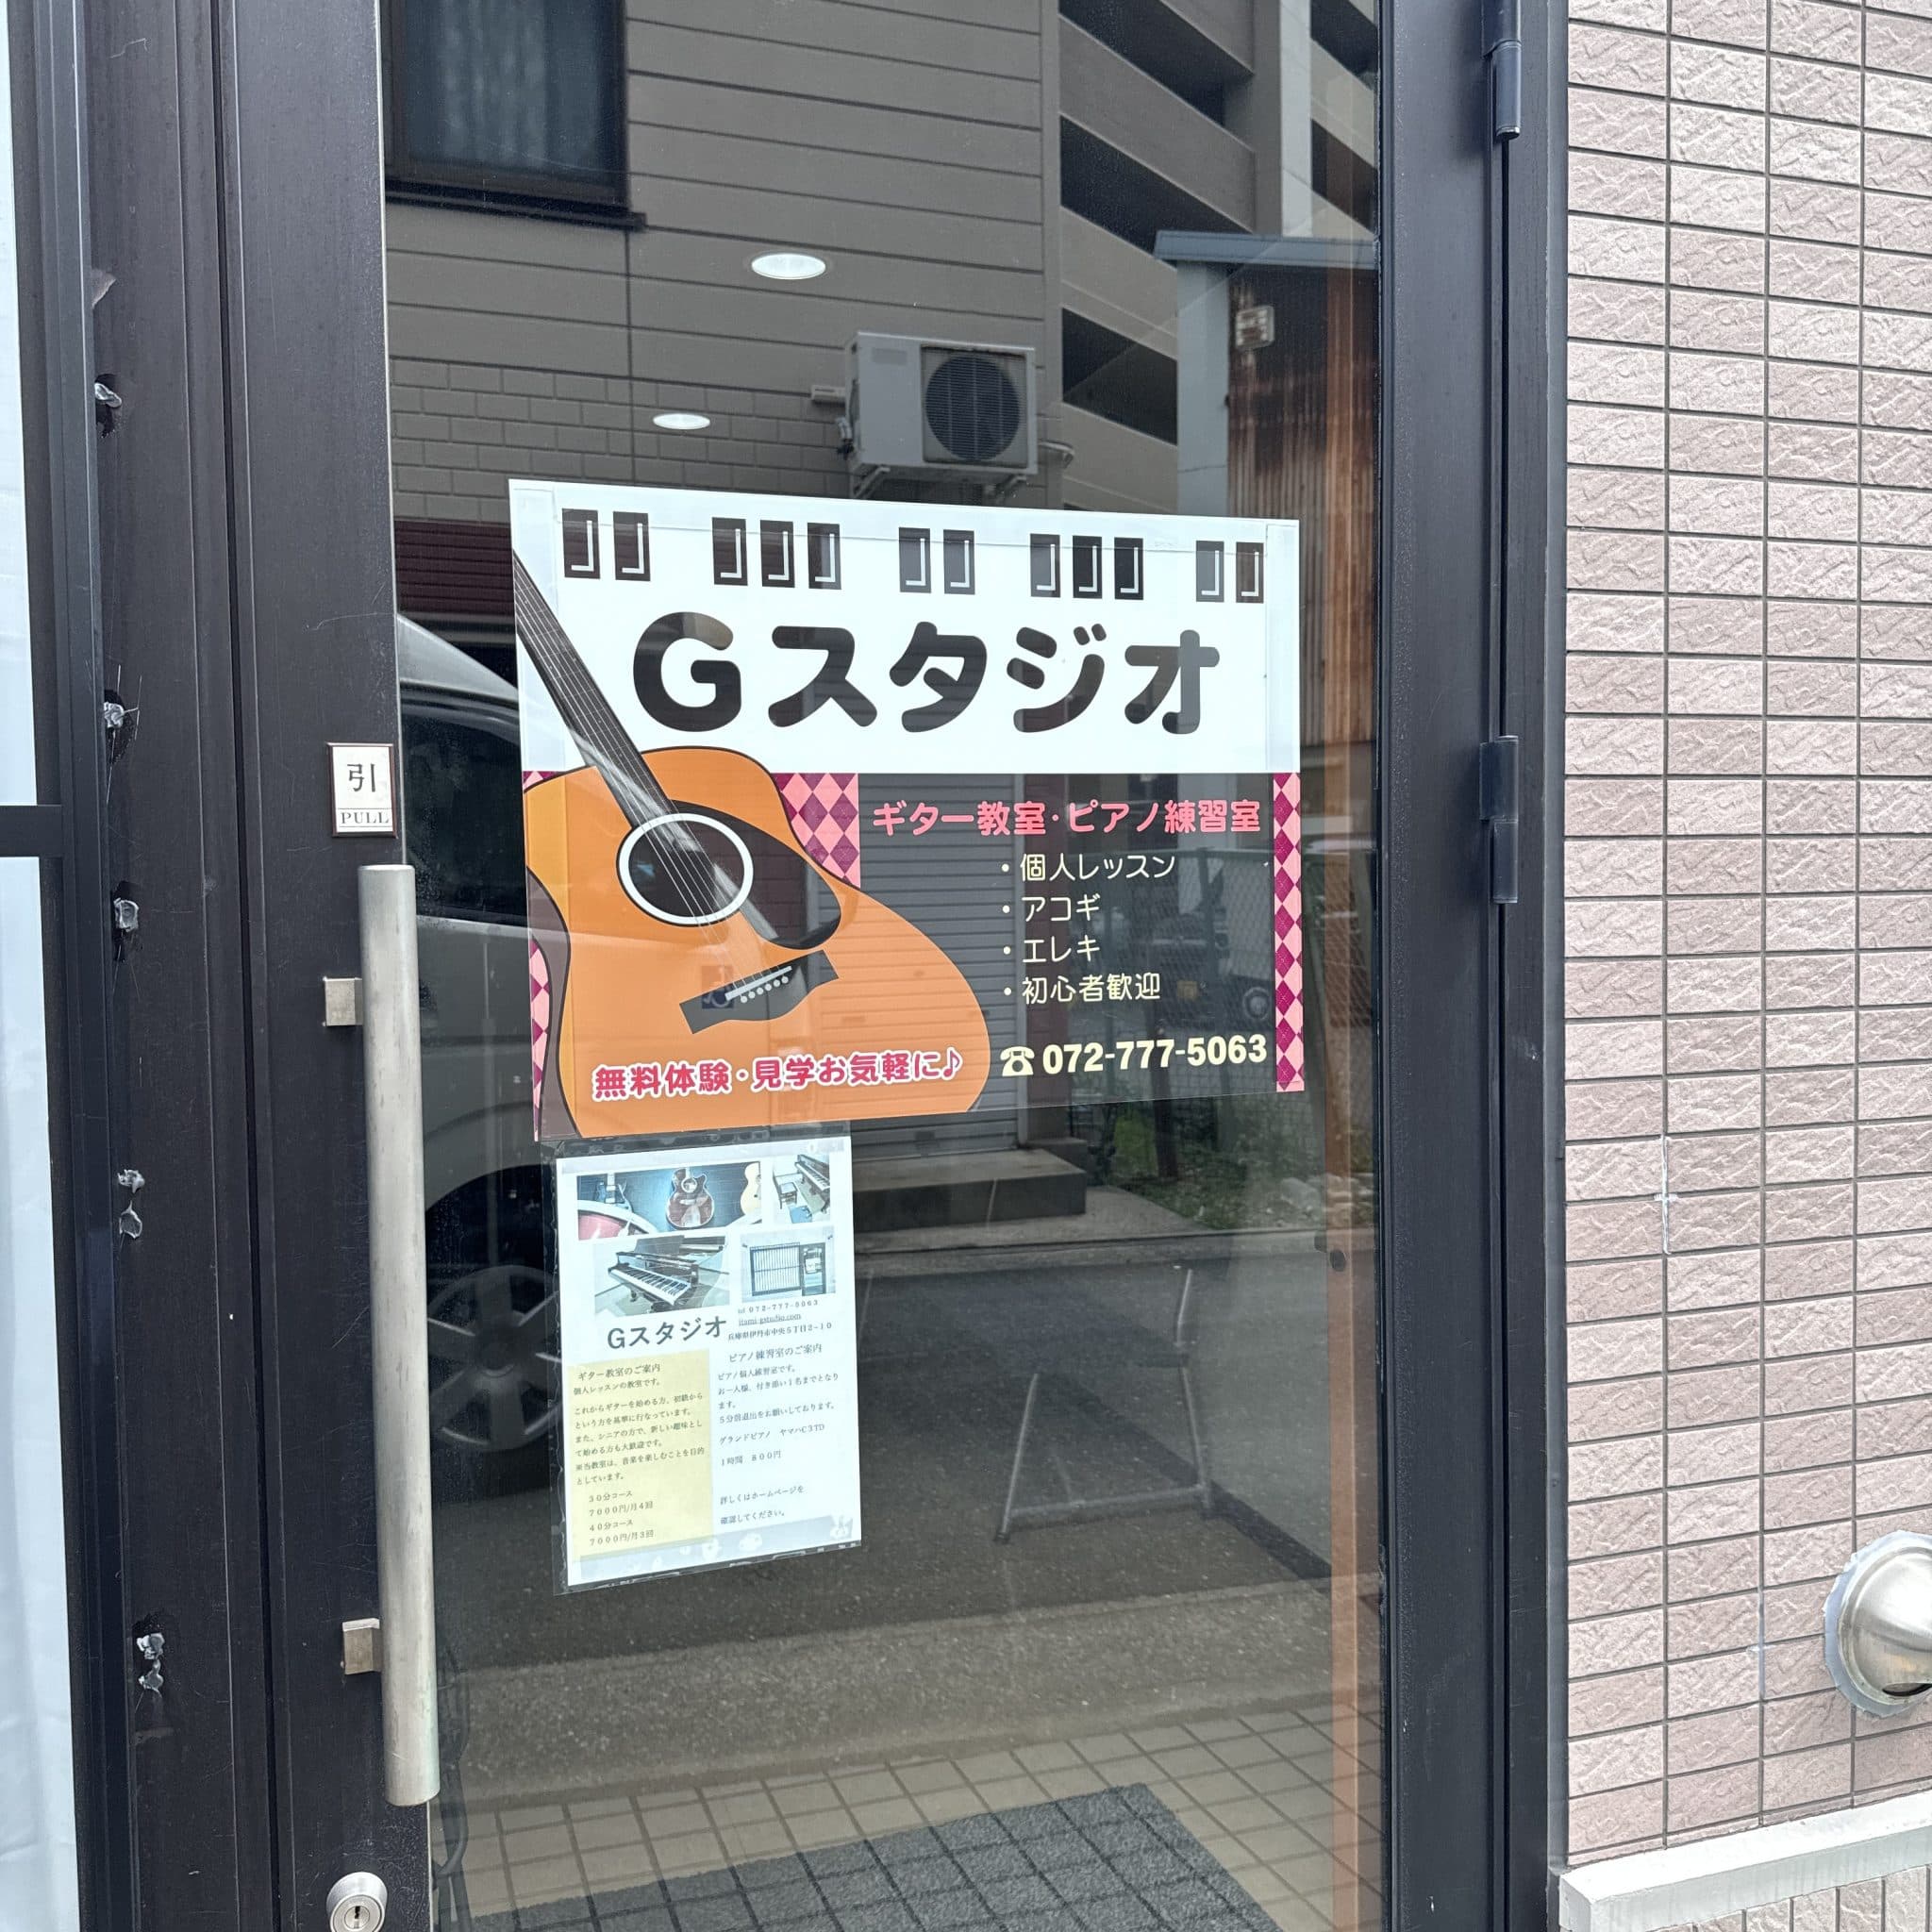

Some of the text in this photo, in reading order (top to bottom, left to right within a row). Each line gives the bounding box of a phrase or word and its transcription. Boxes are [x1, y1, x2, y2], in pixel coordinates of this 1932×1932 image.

[632, 611, 1221, 735] Gスタジオ
[346, 762, 376, 793] 引
[341, 811, 390, 824] PULL
[872, 798, 1262, 837] ギター教室・ピアノ練習室
[1041, 1034, 1268, 1075] 072-777-5063
[607, 1316, 727, 1349] Gスタジオ
[577, 1363, 661, 1381] ギター教室のご案内
